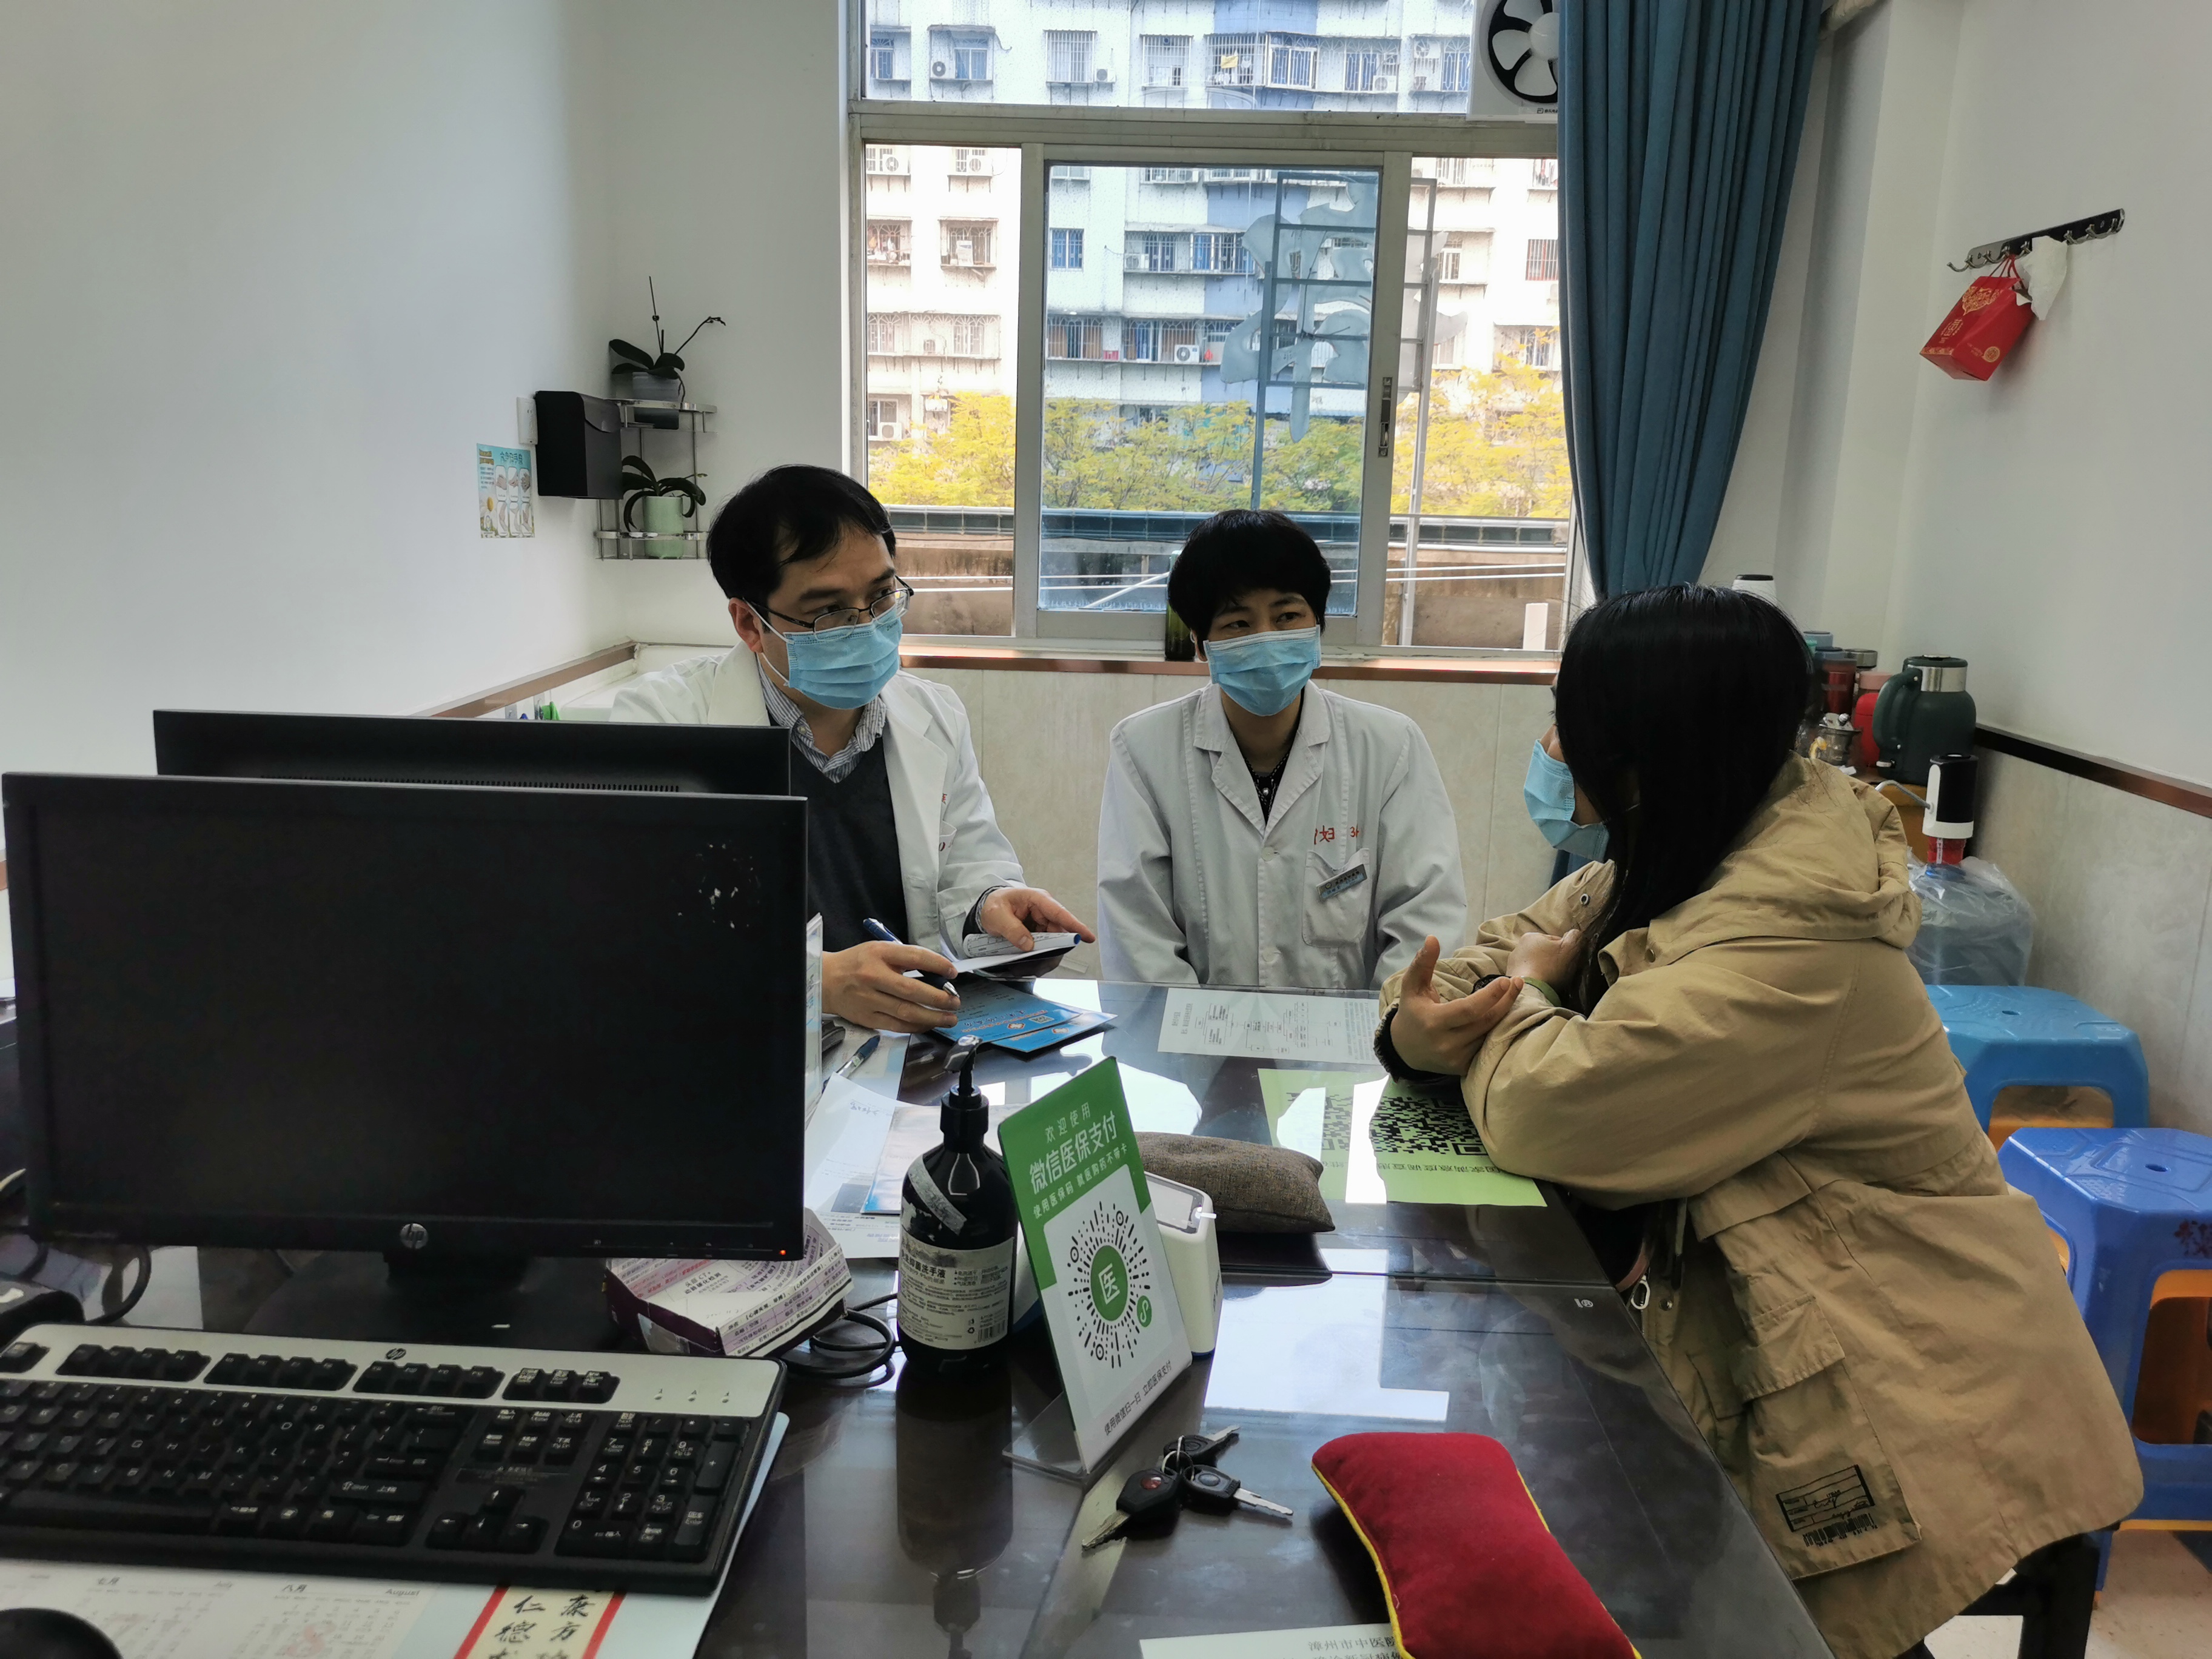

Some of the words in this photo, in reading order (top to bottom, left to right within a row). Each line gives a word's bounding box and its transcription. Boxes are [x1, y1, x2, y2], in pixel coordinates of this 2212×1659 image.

[1030, 1110, 1117, 1195] 微信医保支付
[1045, 1102, 1090, 1144] 欢迎使用
[1033, 1181, 1074, 1219] 使用医保码
[1076, 1143, 1127, 1187] 就医购药不带卡
[1098, 1262, 1121, 1304] 医
[1104, 1393, 1142, 1436] 使用微信扫一扫
[1142, 1359, 1172, 1396] 立即医保支付
[385, 1588, 421, 1597] August
